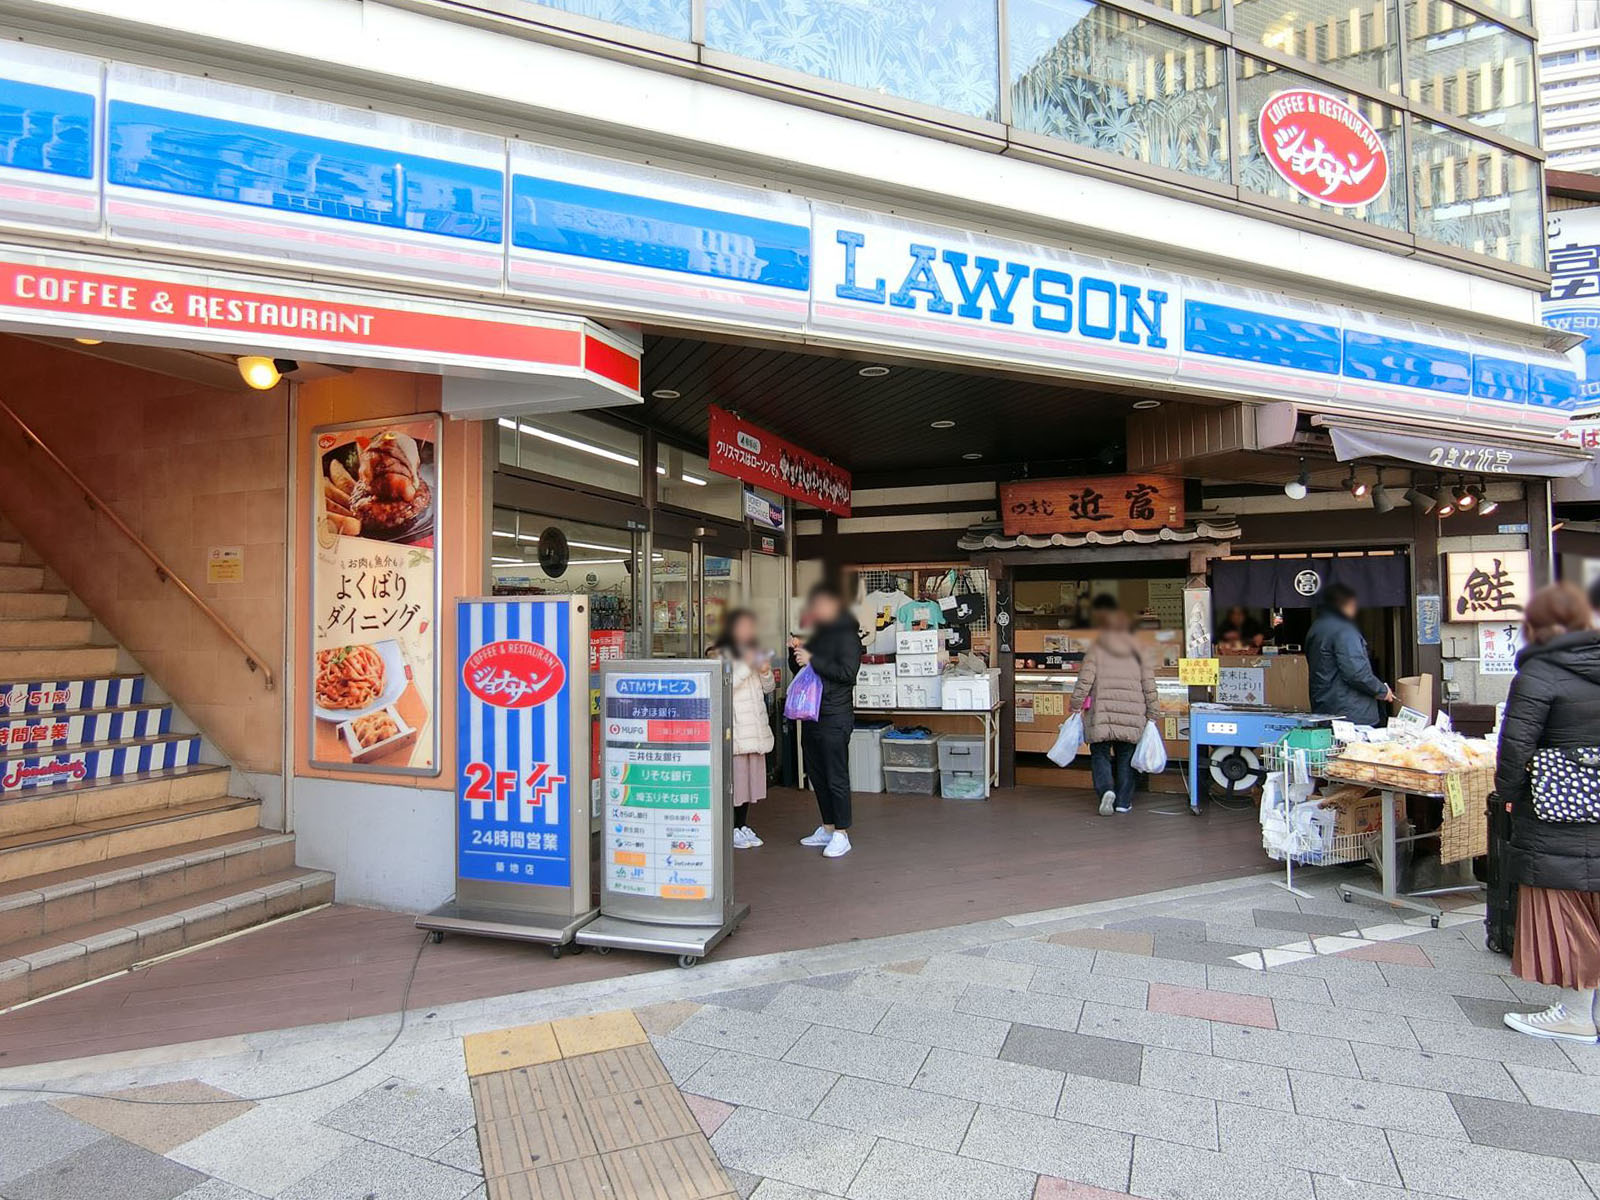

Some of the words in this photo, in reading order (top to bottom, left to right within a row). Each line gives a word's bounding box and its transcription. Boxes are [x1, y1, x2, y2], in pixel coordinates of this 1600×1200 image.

[1267, 95, 1306, 126] COFFEE
[1307, 96, 1316, 113] &
[1318, 97, 1382, 155] RESTAURANT
[1273, 126, 1376, 196] ジョナサン
[15, 273, 138, 311] COFFEE
[150, 291, 175, 316] &
[188, 294, 375, 337] RESTAURANT
[835, 228, 1169, 350] LAWSON
[336, 570, 407, 601] よくばり
[1456, 558, 1526, 616] 鮭
[327, 603, 421, 635] ダイニング
[470, 647, 498, 669] COFFEE
[508, 643, 560, 669] RESTAURANT
[472, 666, 553, 705] ジョナサン
[621, 727, 644, 735] MUFG
[463, 762, 517, 801] 2F
[641, 769, 692, 782] りそな銀行
[471, 830, 558, 852] 24時間営業
